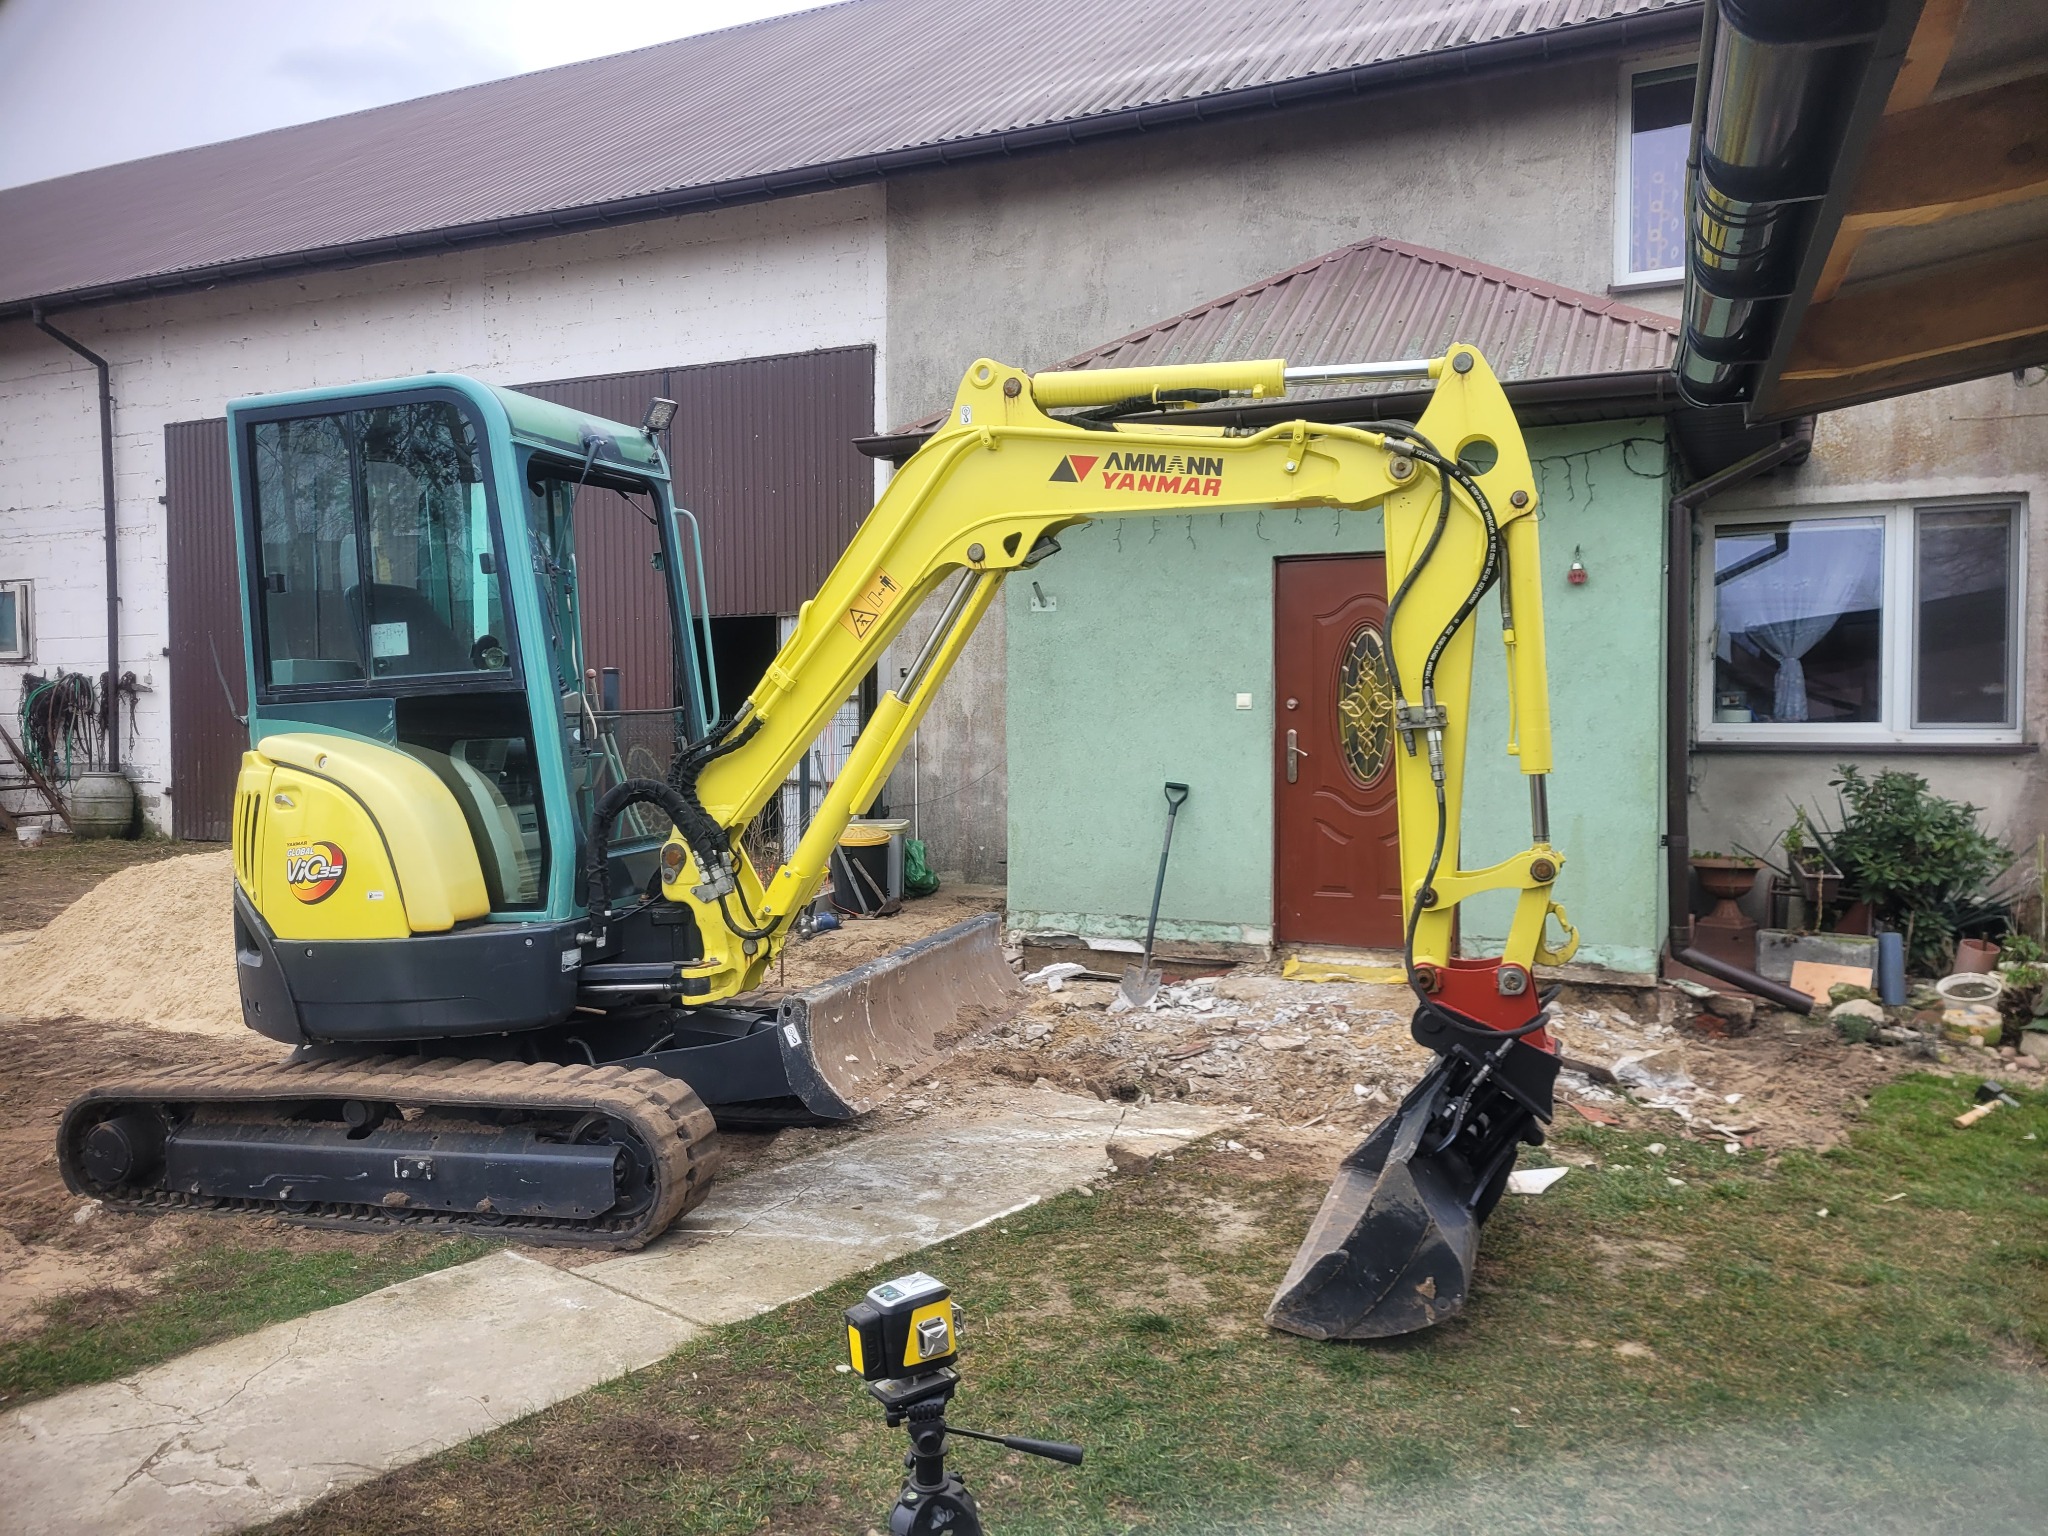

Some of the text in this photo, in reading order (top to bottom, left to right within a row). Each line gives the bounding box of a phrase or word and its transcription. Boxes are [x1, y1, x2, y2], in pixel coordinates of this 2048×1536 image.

[1103, 451, 1224, 476] AMMANN
[1102, 472, 1222, 497] YANMAR
[286, 847, 315, 857] GLOBAL
